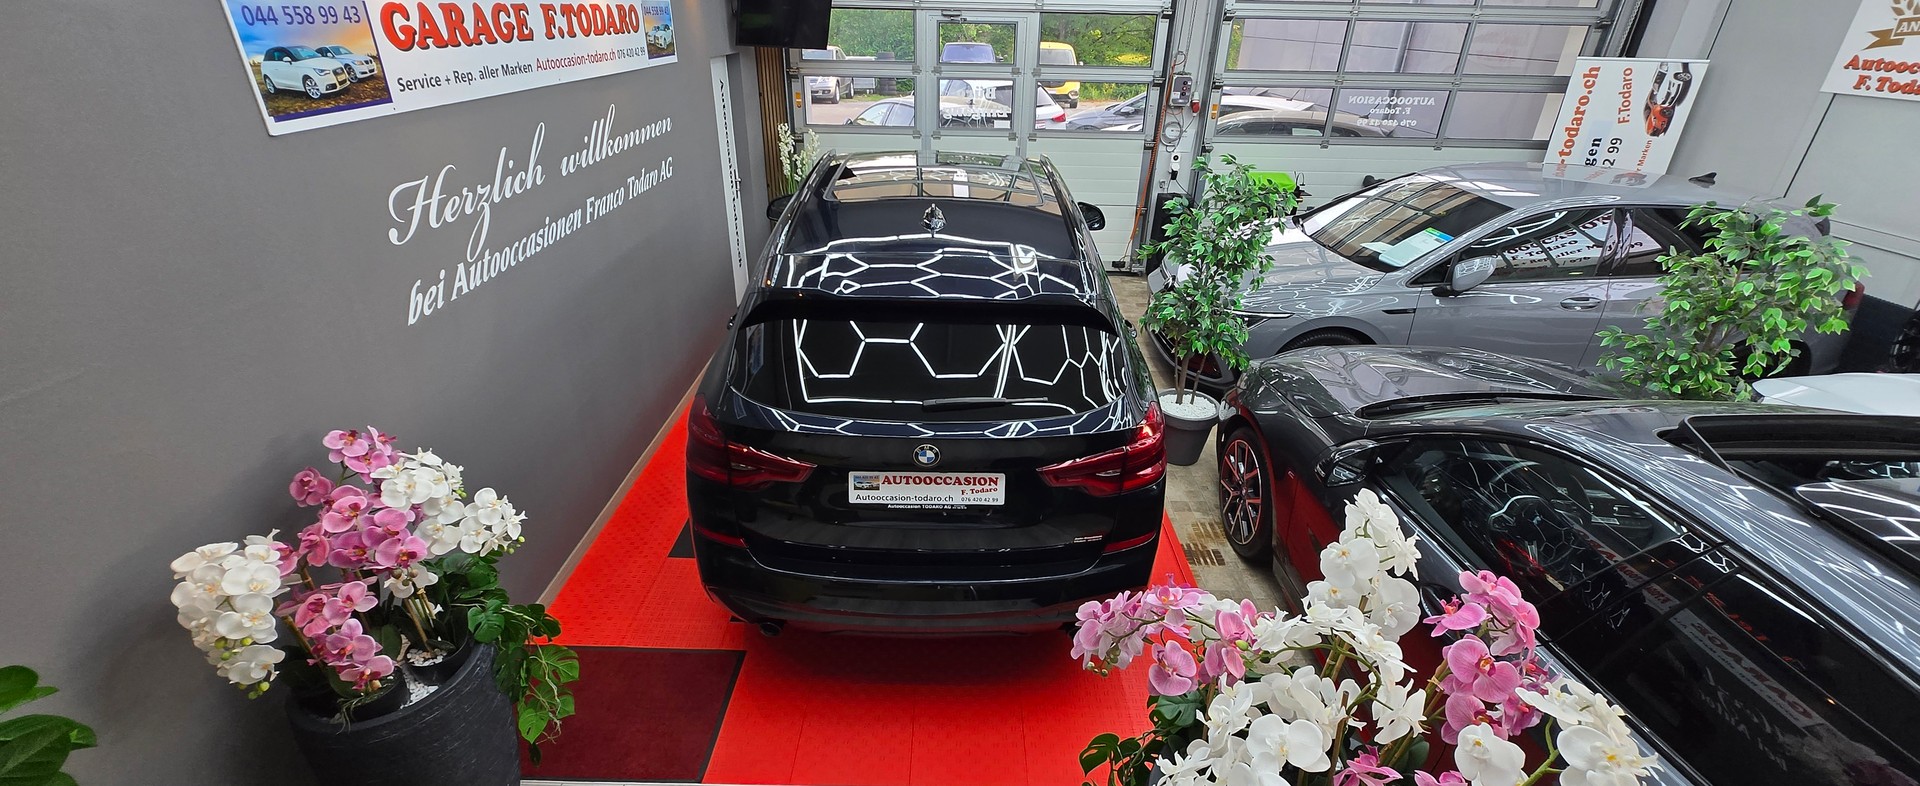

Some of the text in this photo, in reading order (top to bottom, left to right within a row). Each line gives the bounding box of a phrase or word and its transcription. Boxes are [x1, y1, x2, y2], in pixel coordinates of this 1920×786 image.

[241, 5, 361, 26] 044 558 99 43
[380, 1, 640, 52] GARAGE F.TODARO
[1896, 20, 1920, 33] AN
[397, 70, 442, 93] Service
[445, 76, 451, 85] +
[453, 69, 477, 86] Rep.
[478, 65, 499, 81] aller
[502, 62, 533, 78] Marken
[536, 48, 616, 72] Autooccasion-todaro.ch
[617, 50, 626, 60] 076
[626, 49, 634, 58] 420
[1853, 74, 1871, 91] F.
[1617, 67, 1633, 124] F.Todaro
[1584, 137, 1602, 166] gen
[1607, 137, 1622, 154] 99
[1637, 140, 1653, 167] Marken
[388, 104, 672, 263] Herzlich willkommen
[408, 156, 673, 326] bei Autooccasionen Franco Todaro AG
[881, 475, 999, 487] AUTOOCCASION
[970, 487, 998, 495] Todaro
[855, 493, 954, 502] Autooccasion-todaro.ch
